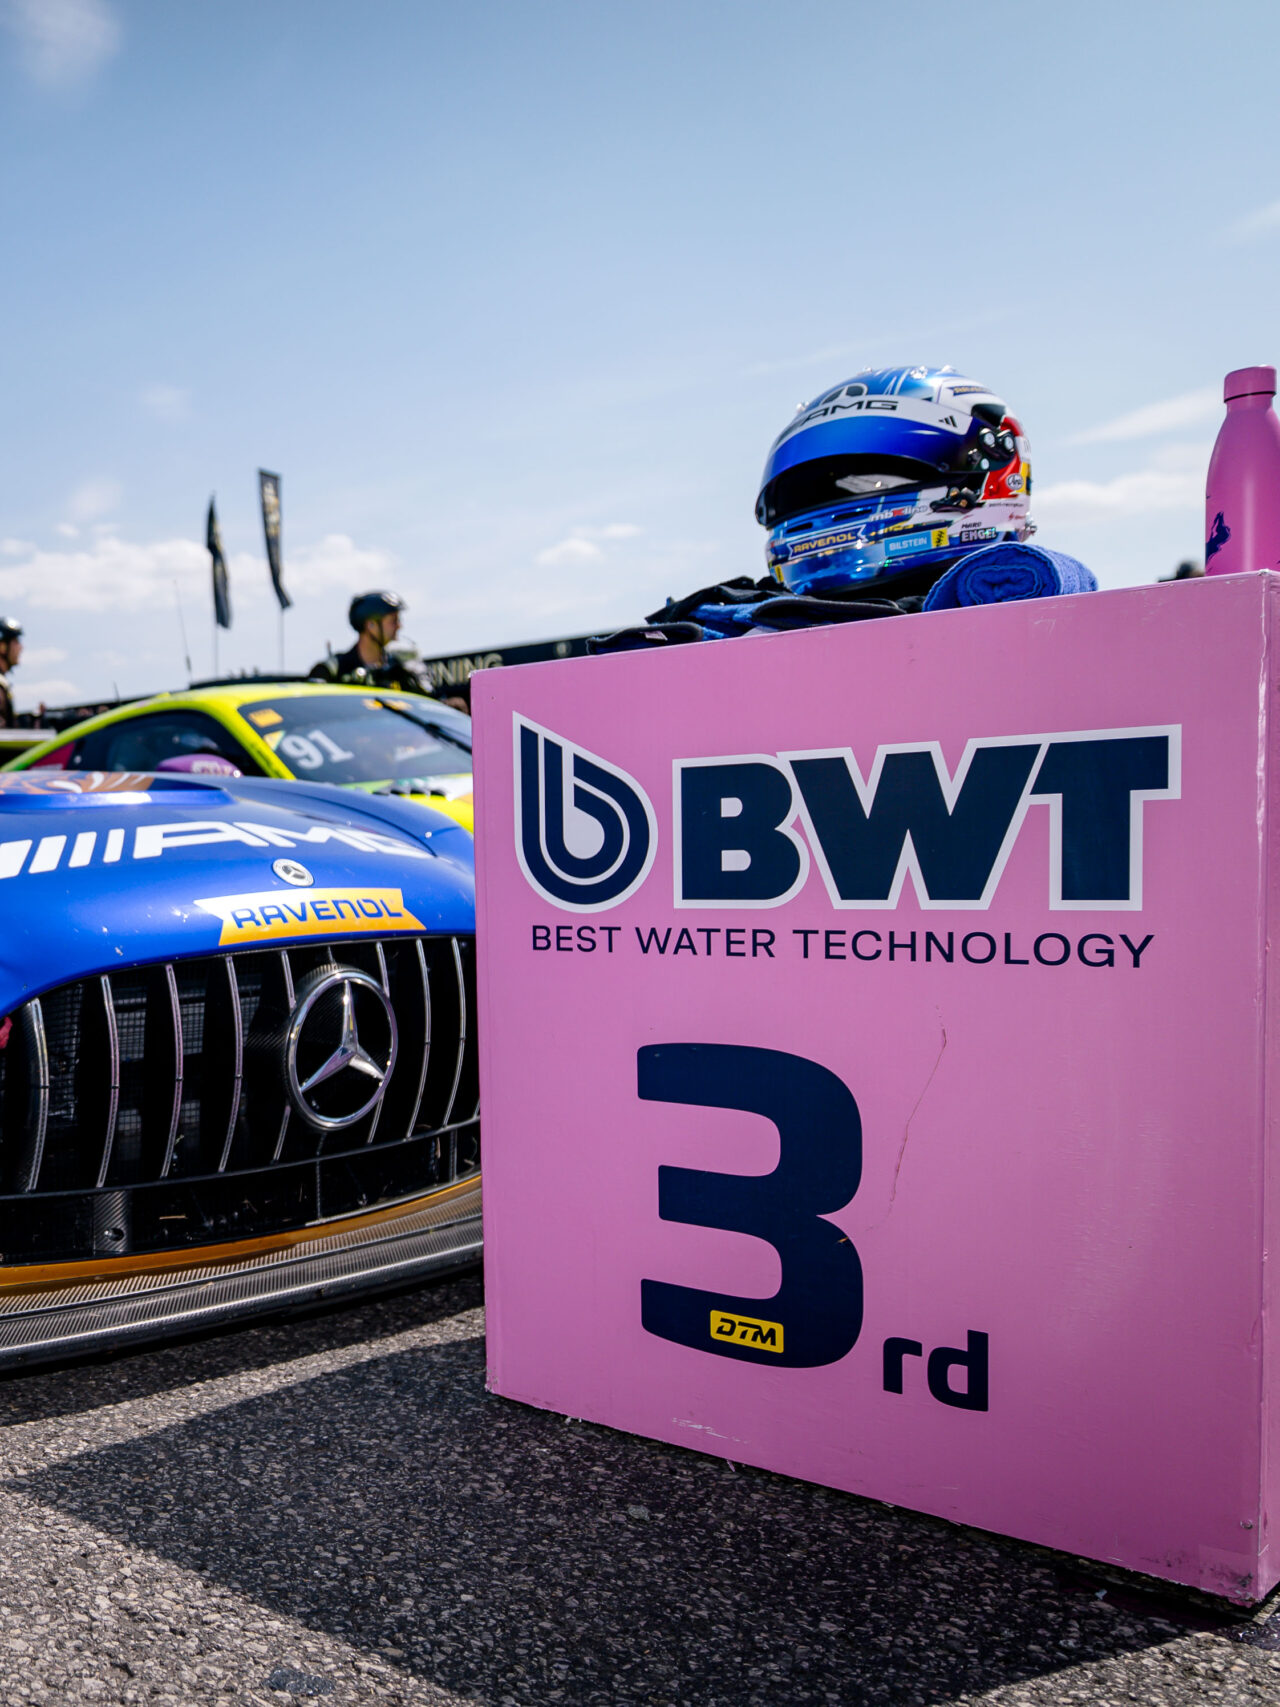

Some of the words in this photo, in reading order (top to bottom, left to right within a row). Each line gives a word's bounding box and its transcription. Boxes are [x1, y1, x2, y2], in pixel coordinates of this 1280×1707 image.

[803, 399, 899, 426] AMG
[793, 531, 856, 553] RAVENOL
[889, 536, 928, 551] BILSTEIN
[961, 528, 997, 542] ENGEL
[280, 729, 355, 769] 91
[678, 734, 1172, 902] BWT
[133, 821, 434, 859] AMG
[230, 897, 404, 929] RAVENOL
[531, 925, 621, 952] BEST
[634, 927, 776, 958] WATER
[792, 930, 1155, 969] TECHNOLOGY
[716, 1317, 777, 1347] DTM
